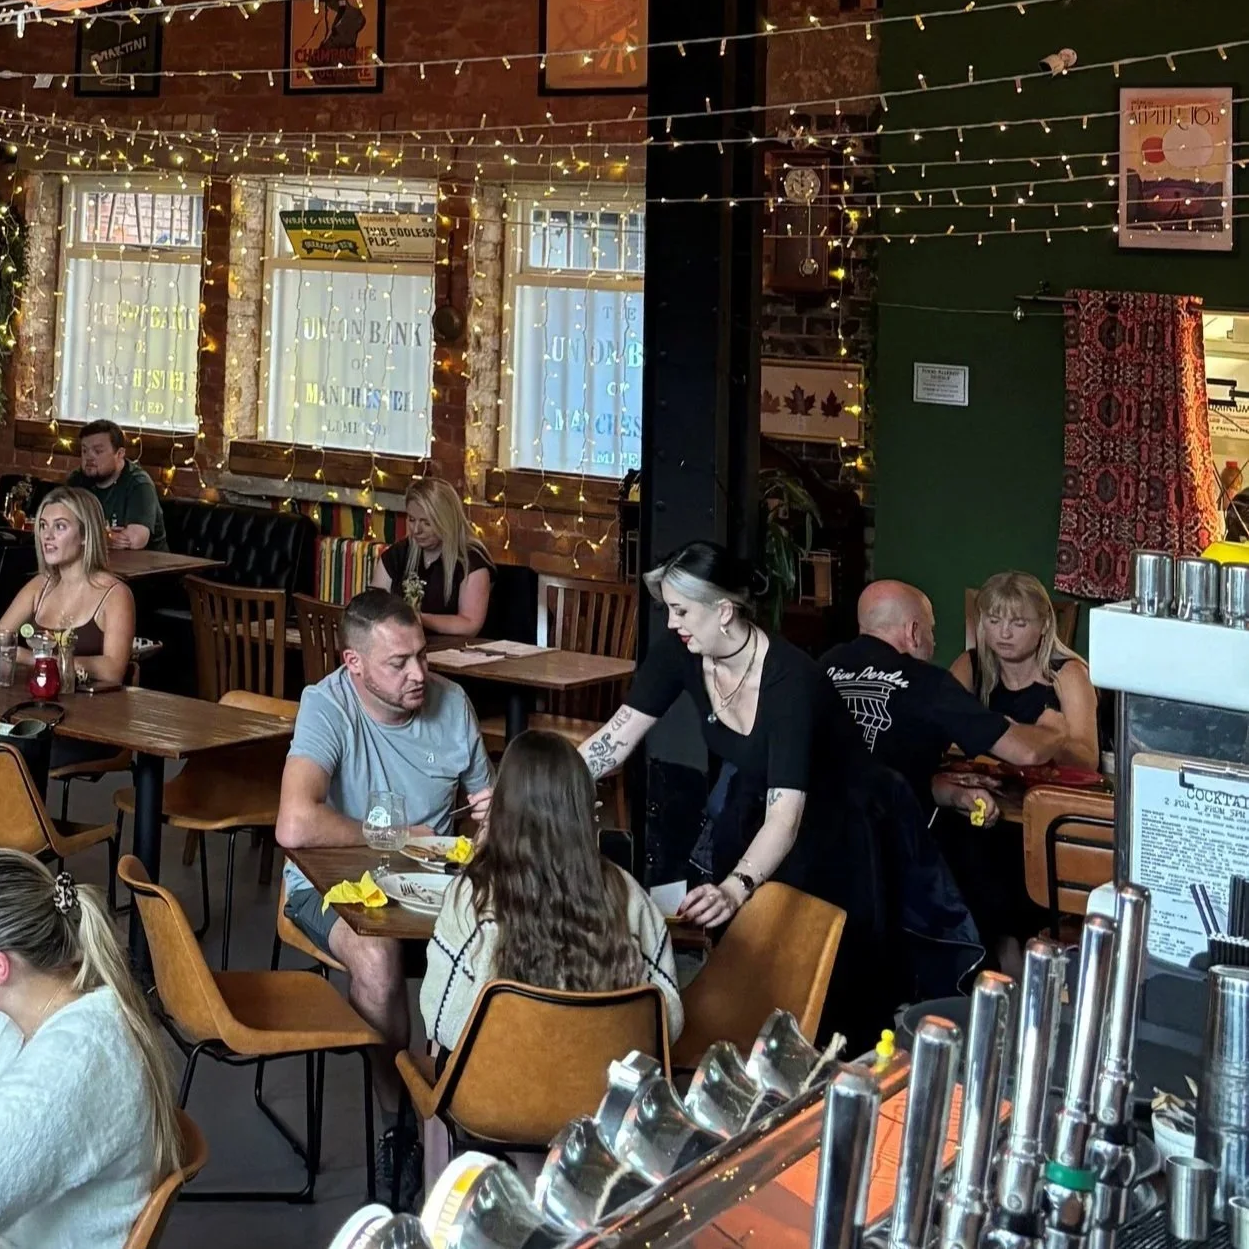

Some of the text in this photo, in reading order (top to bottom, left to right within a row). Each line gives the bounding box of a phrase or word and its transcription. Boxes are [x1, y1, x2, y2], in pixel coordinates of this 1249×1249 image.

[91, 36, 147, 63] MARTINI
[390, 225, 436, 238] GODLESS
[603, 306, 637, 321] TE
[370, 319, 422, 347] BANK
[306, 382, 415, 413] MANCHESTER
